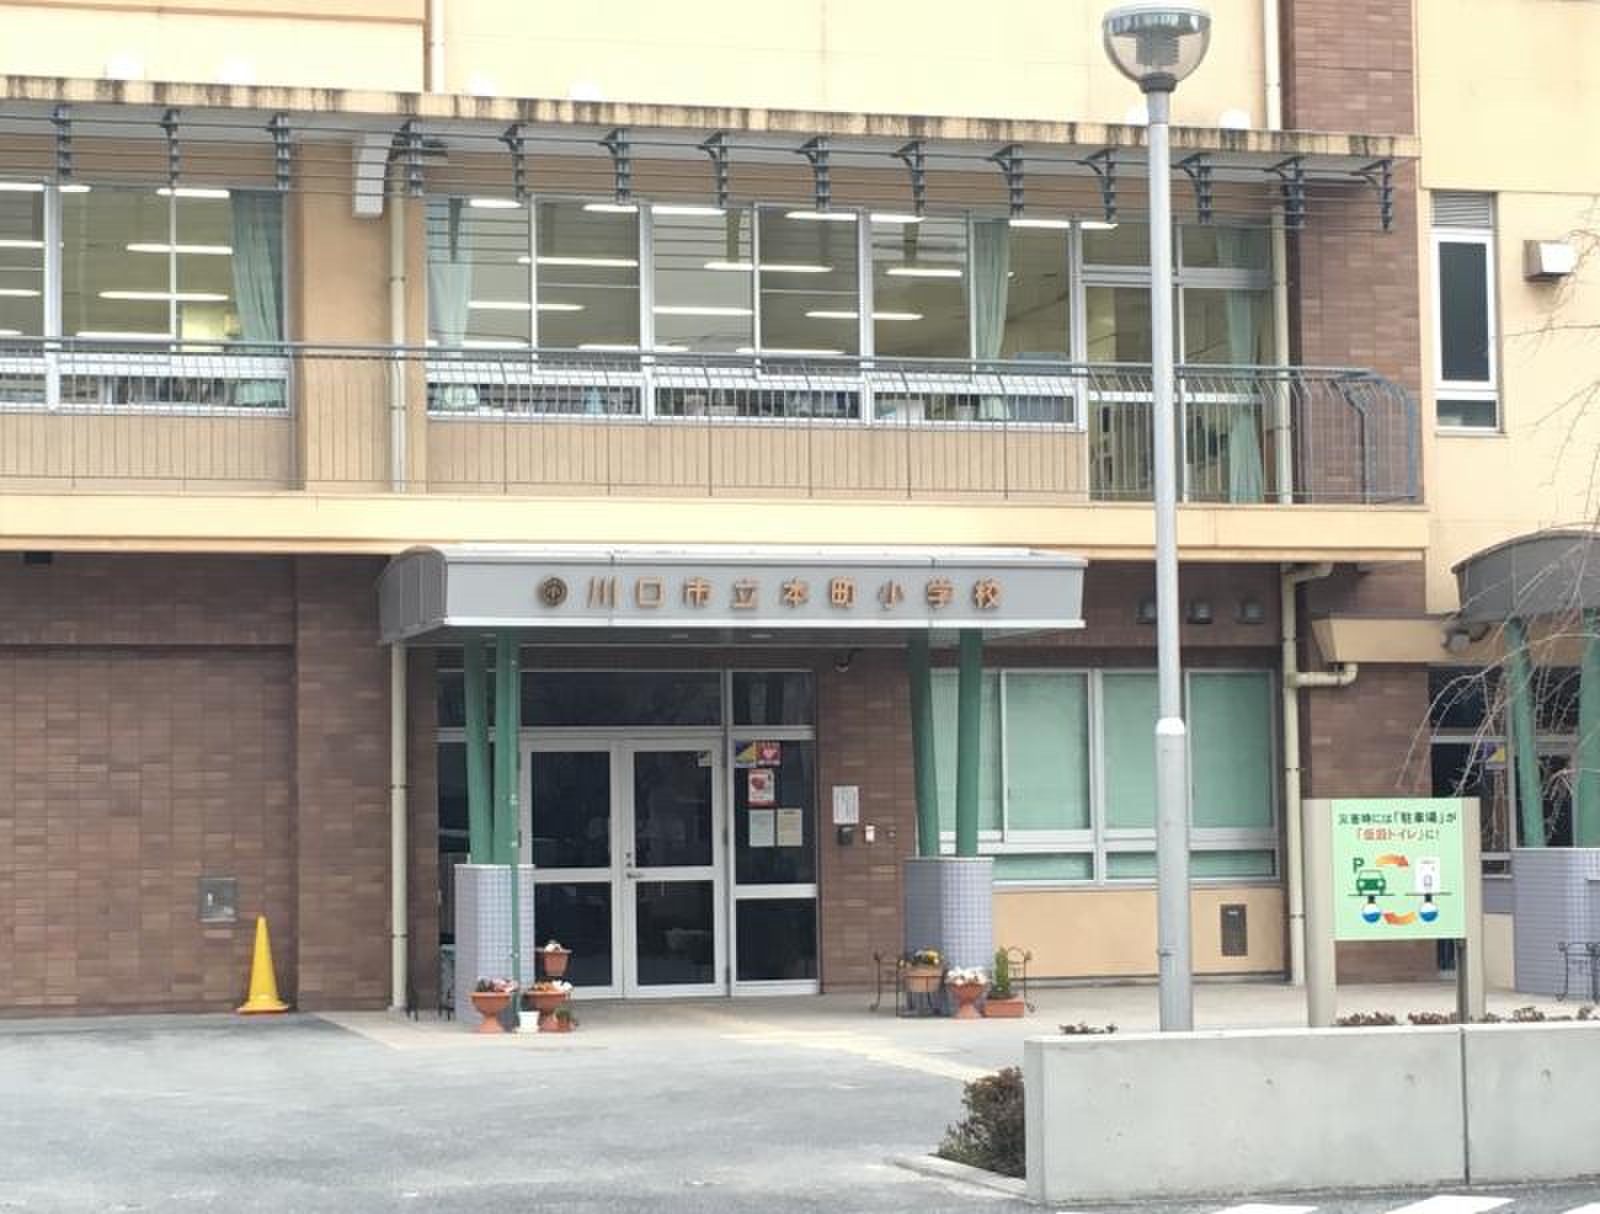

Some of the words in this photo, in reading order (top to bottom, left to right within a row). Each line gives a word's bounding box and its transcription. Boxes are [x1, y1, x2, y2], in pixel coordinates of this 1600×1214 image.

[586, 576, 1005, 610] 川口市立本町小学校
[1353, 857, 1365, 873] P
